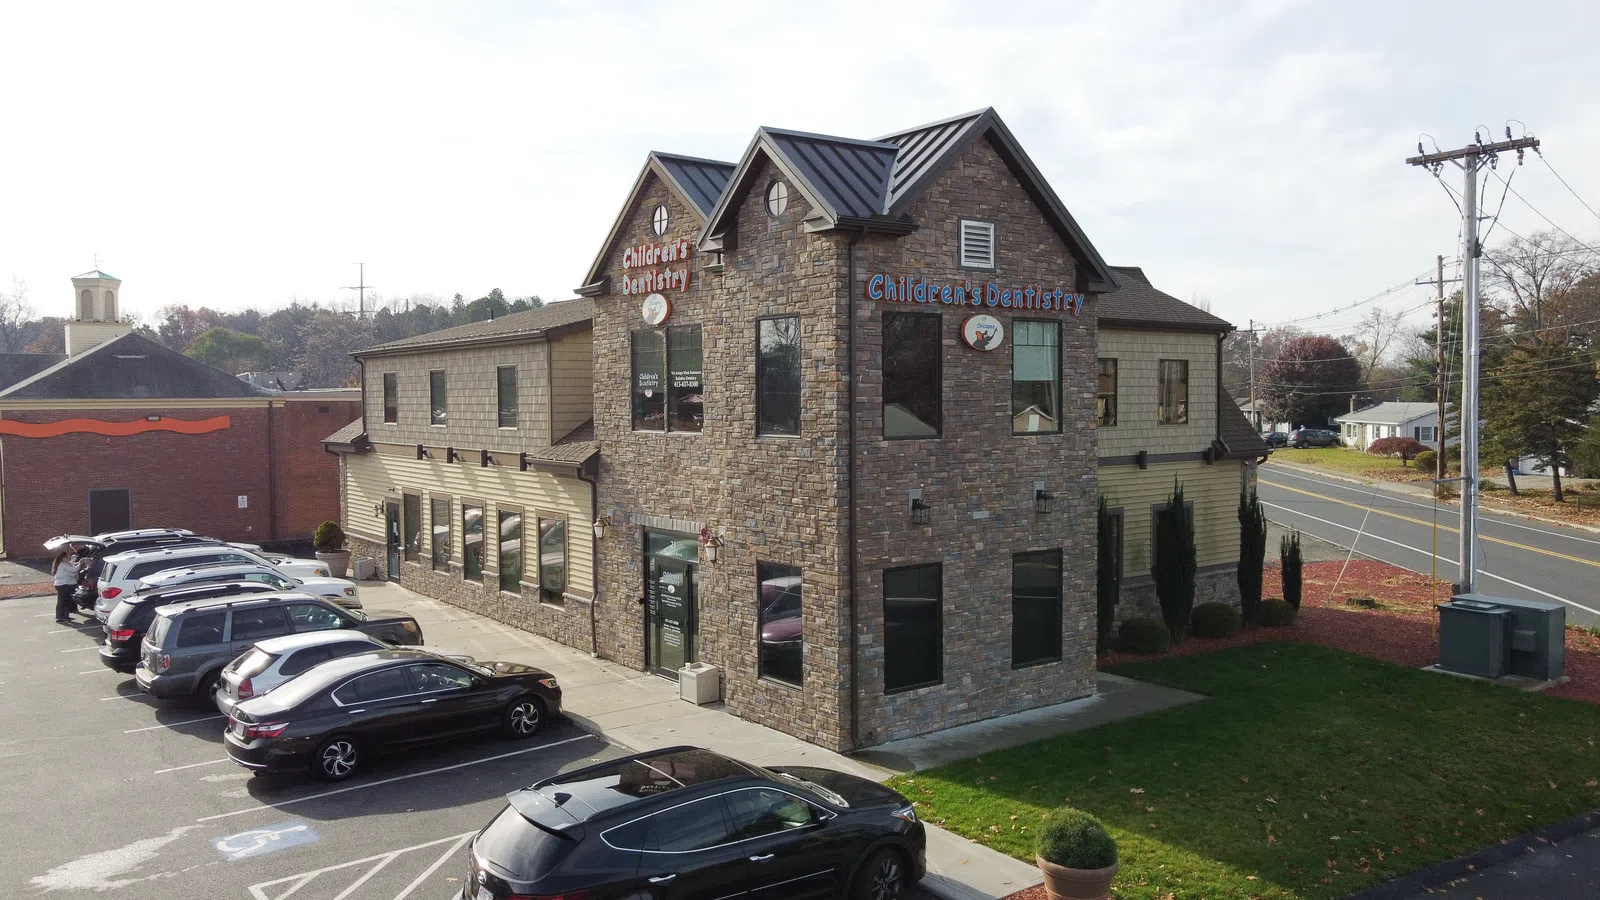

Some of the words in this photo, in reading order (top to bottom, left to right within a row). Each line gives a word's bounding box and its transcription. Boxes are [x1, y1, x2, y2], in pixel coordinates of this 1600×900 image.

[623, 238, 689, 270] Children's
[623, 267, 689, 295] Dentistry
[867, 274, 982, 306] Children's
[985, 281, 1085, 316] Dentistry
